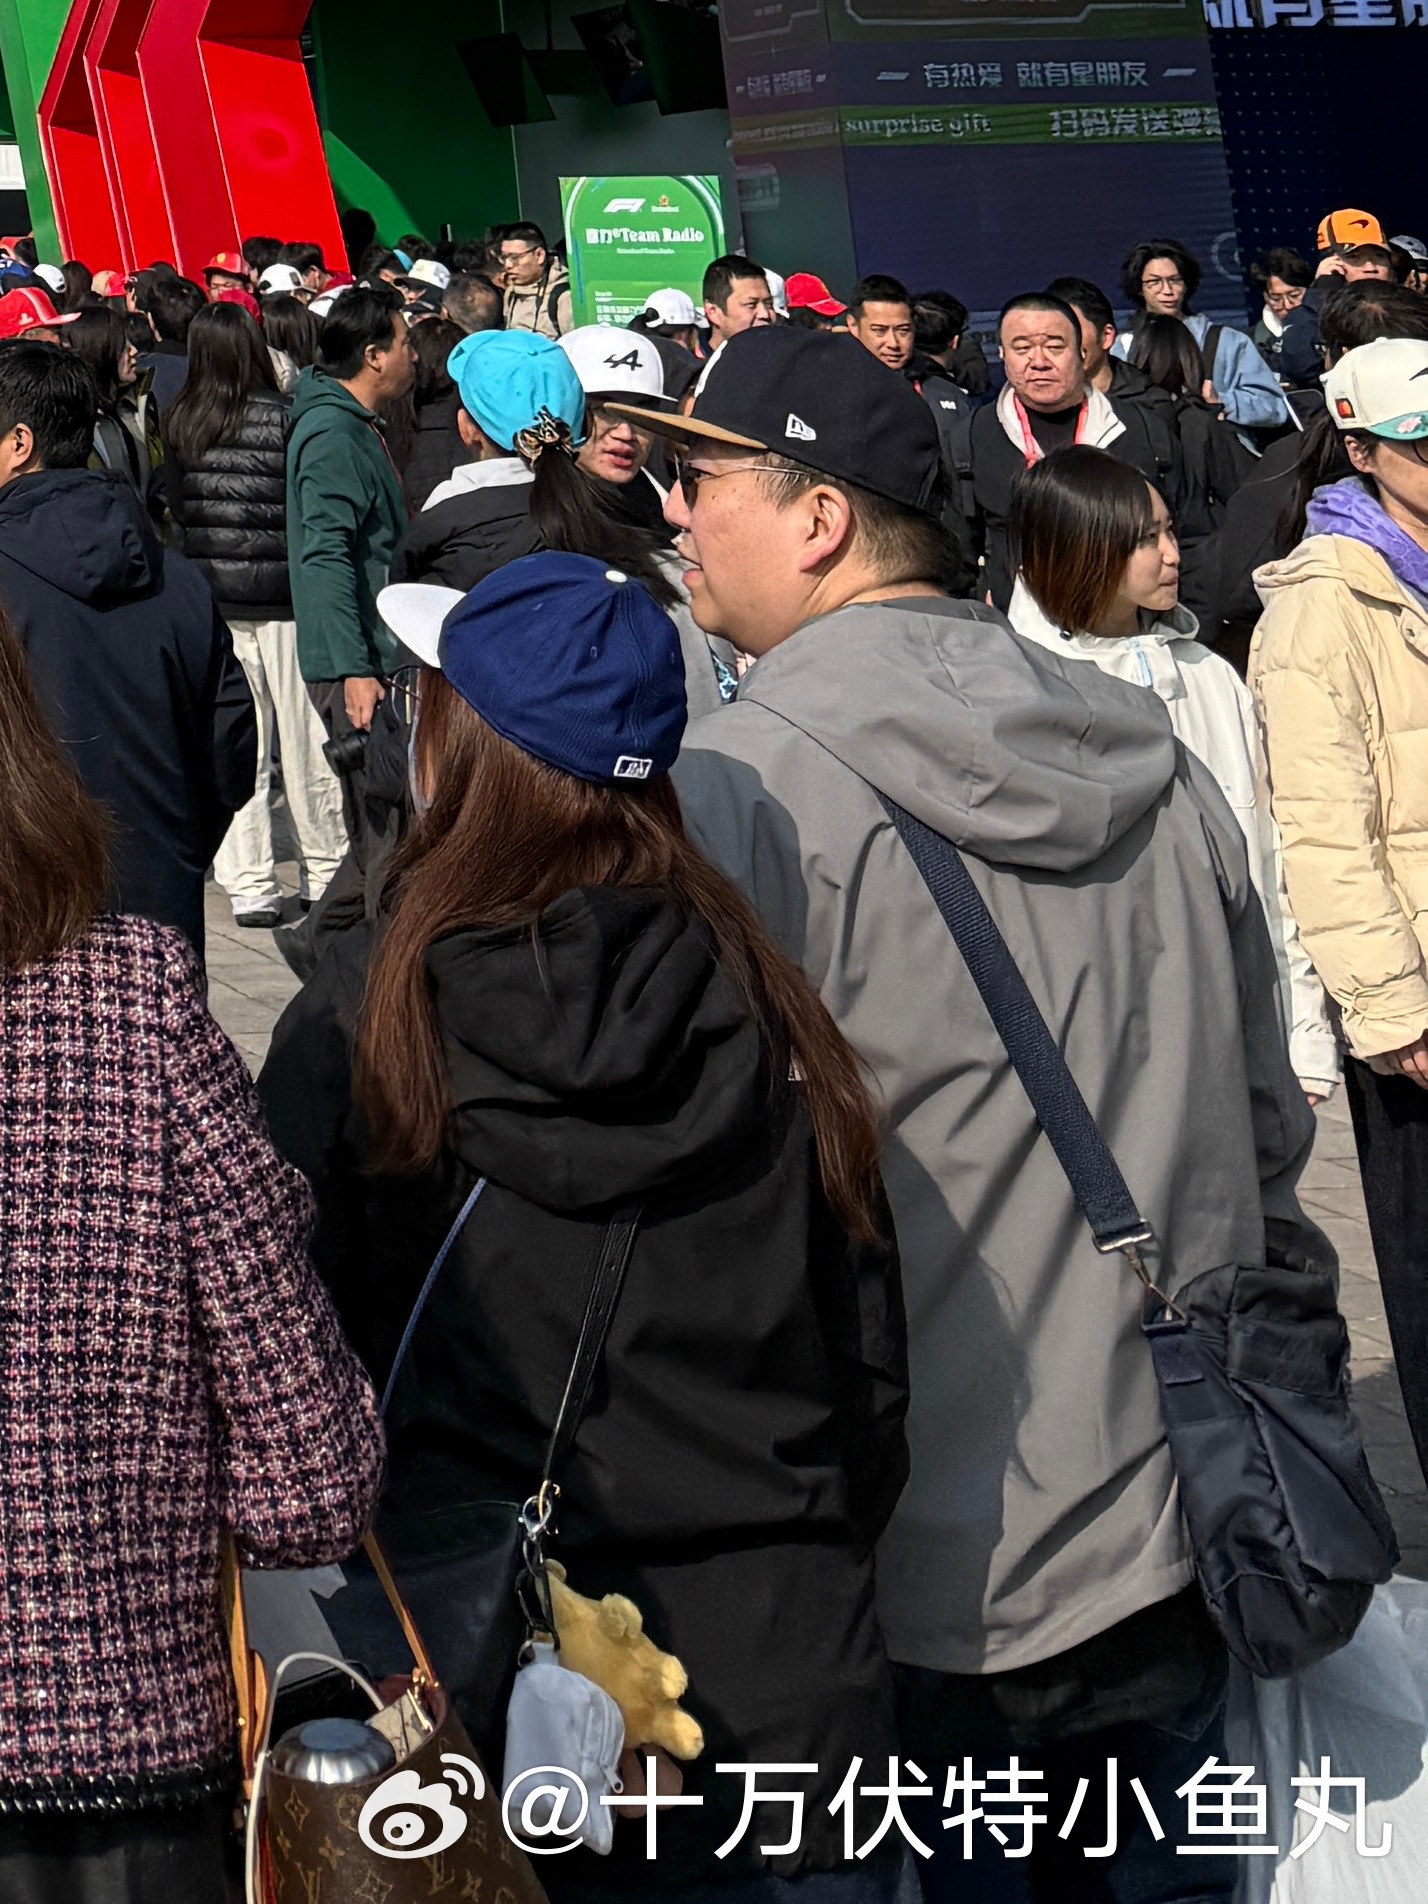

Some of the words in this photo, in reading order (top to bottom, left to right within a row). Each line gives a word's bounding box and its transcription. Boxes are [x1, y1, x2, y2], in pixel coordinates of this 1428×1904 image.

[923, 62, 1003, 89] 有热爱
[1016, 61, 1148, 89] 就有星朋友
